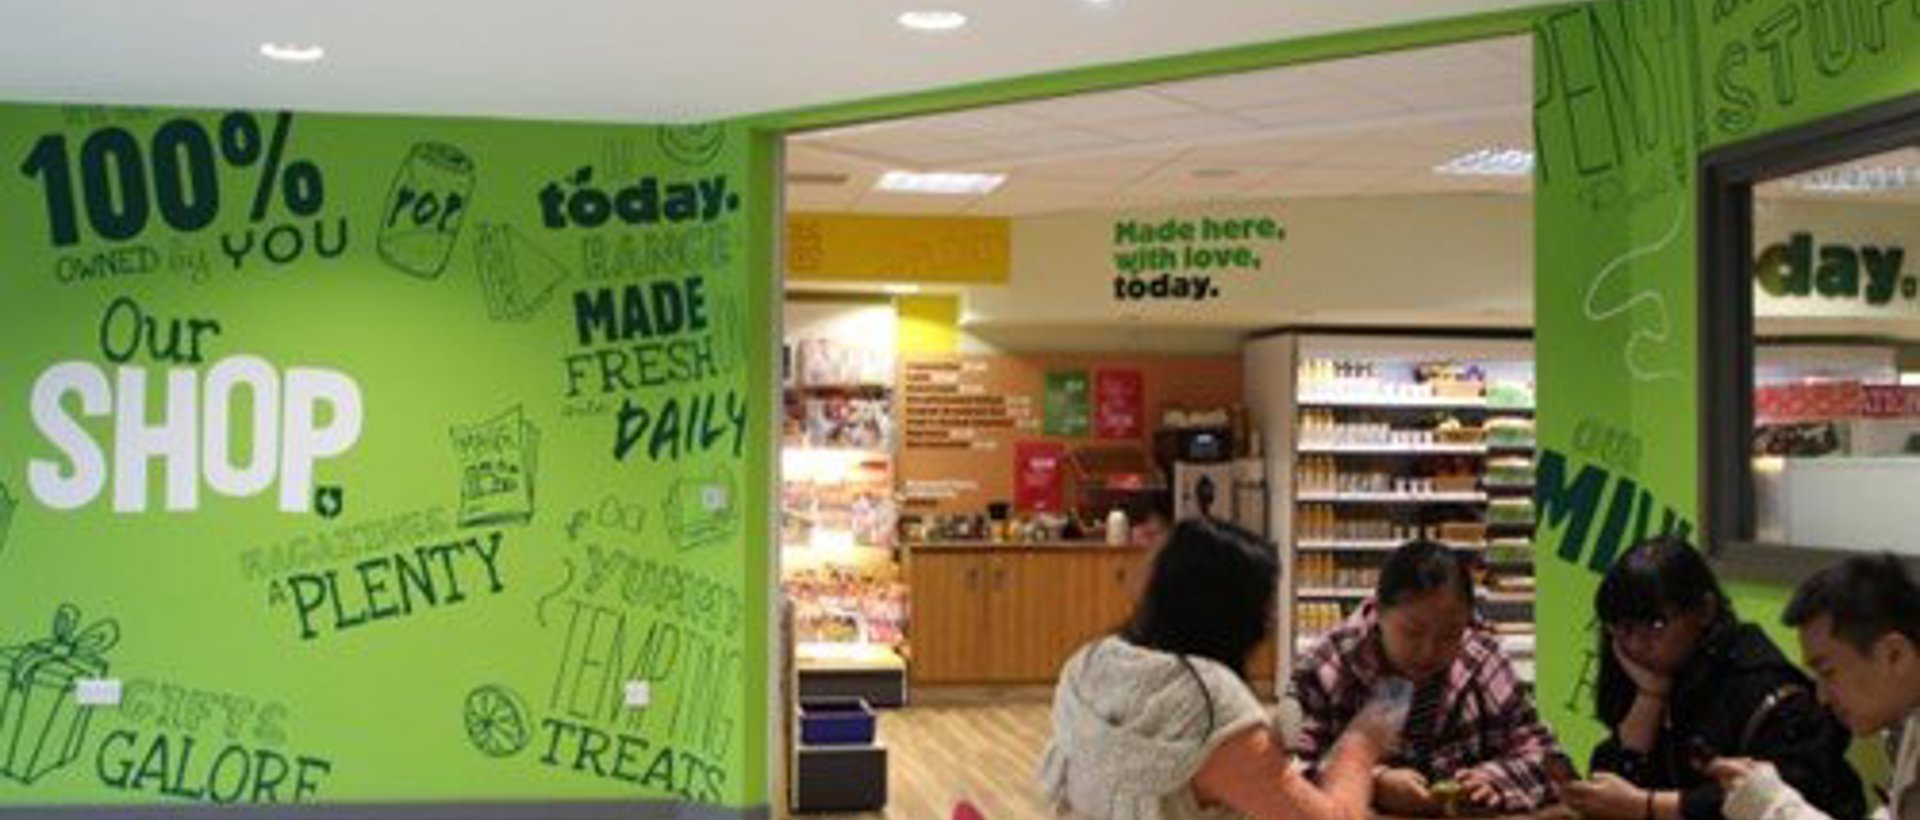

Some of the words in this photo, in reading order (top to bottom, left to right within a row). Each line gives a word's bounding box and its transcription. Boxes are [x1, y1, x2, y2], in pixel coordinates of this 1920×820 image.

[21, 111, 323, 246] 100%
[56, 246, 160, 284] OWNED
[221, 217, 347, 270] YOU
[1114, 216, 1195, 244] Made
[1201, 214, 1287, 242] here,
[1114, 245, 1177, 272] with
[1184, 246, 1261, 270] love,
[573, 277, 707, 346] MADE
[1114, 272, 1220, 301] today.
[101, 296, 221, 364] Our
[562, 337, 718, 397] FRESH
[613, 387, 747, 461] DAILY
[287, 531, 504, 640] PLENTY
[539, 717, 726, 802] TREATS
